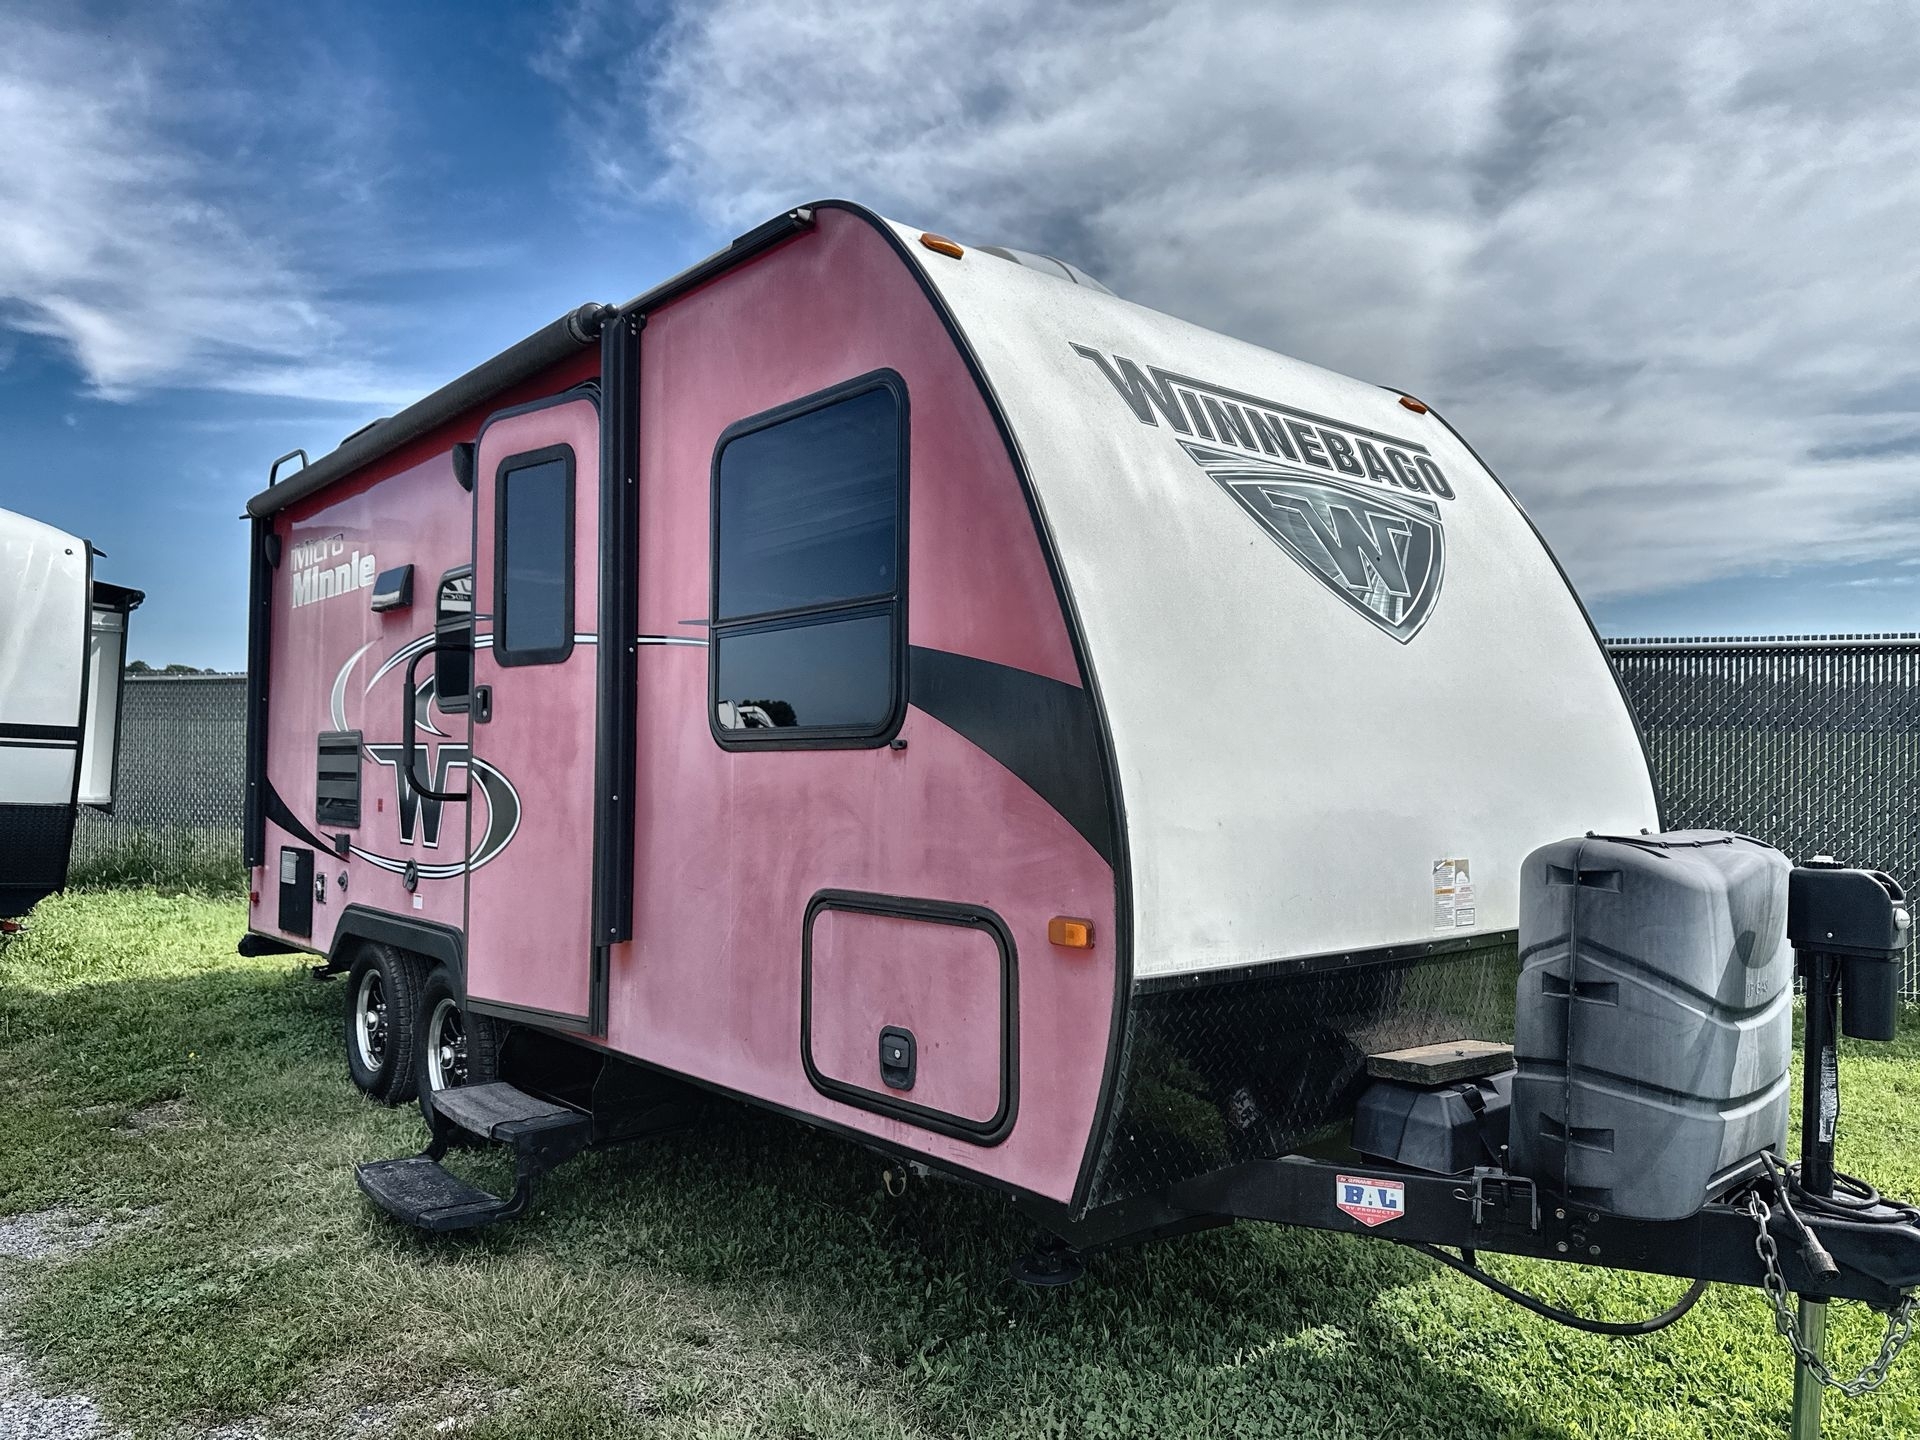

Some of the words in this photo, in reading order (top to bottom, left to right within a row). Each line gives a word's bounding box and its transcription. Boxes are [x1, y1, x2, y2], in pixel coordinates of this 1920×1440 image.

[1069, 342, 1456, 500] WINNEBAGO
[292, 550, 376, 609] Minnie
[1257, 486, 1413, 598] W
[363, 743, 469, 848] W
[1344, 1185, 1397, 1209] BAL
[1357, 1207, 1395, 1216] PRODUCTS
